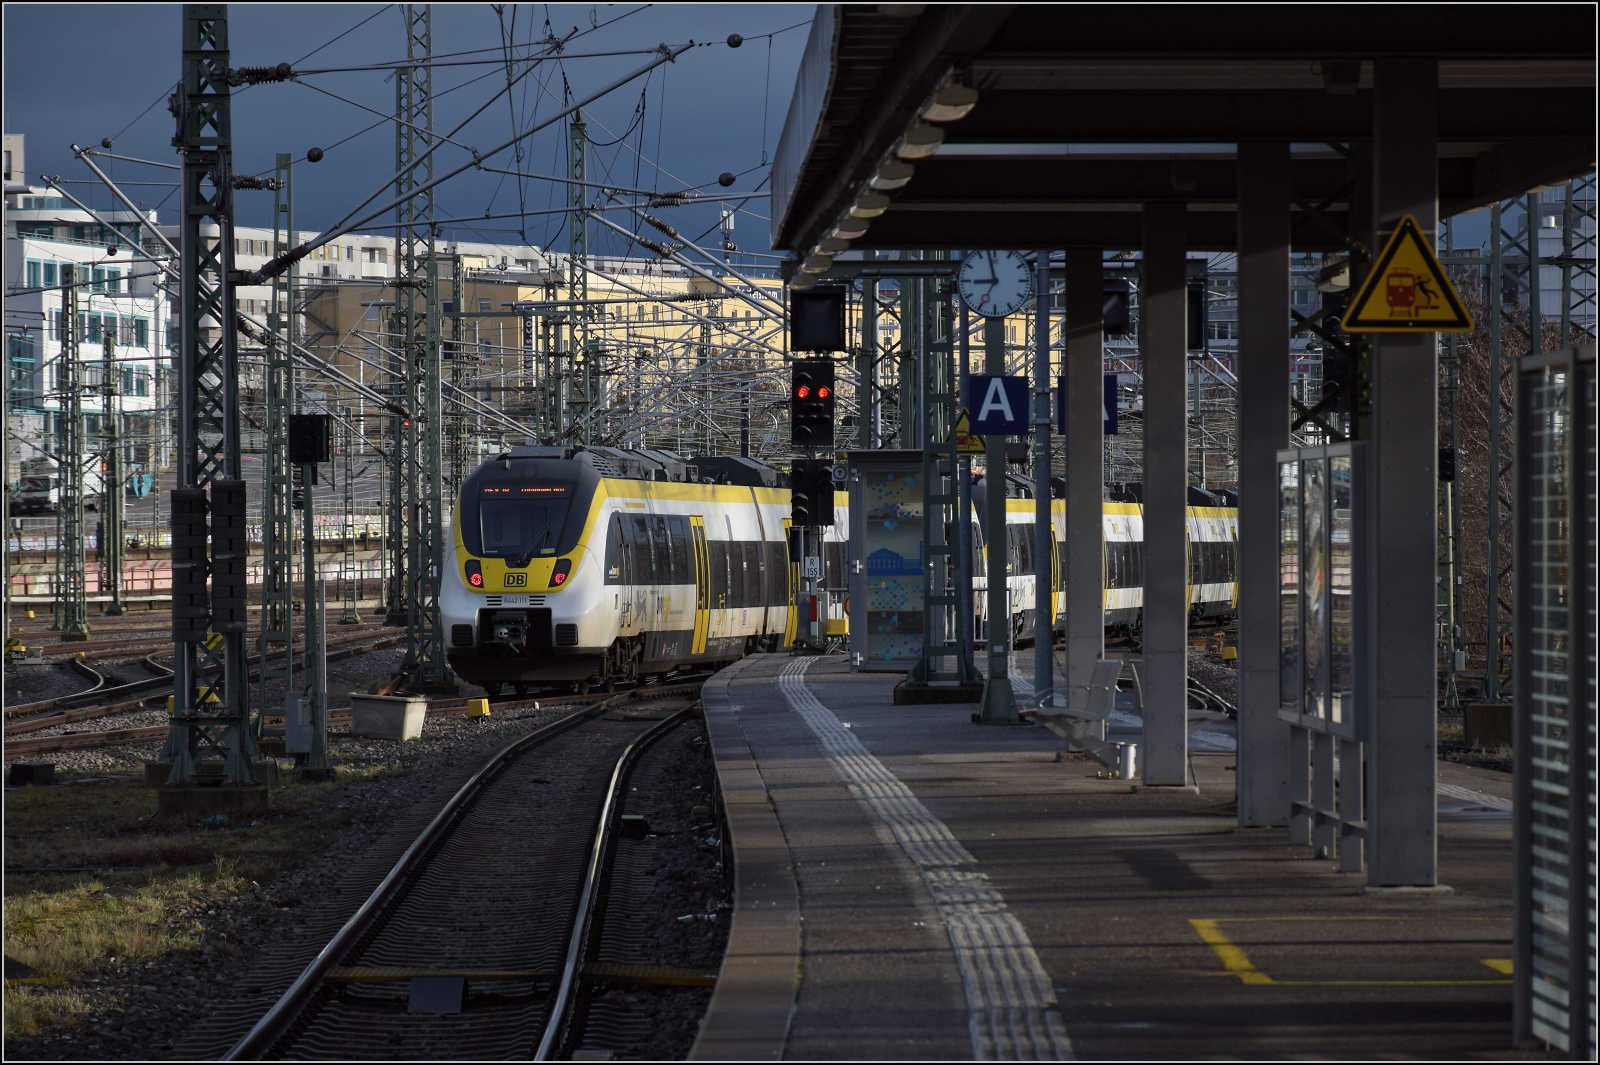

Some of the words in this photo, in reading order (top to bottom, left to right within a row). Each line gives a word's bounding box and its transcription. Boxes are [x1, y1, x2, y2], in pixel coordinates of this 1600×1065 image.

[978, 377, 1015, 422] A
[809, 558, 815, 567] R
[807, 568, 818, 576] 155
[507, 574, 525, 585] DB
